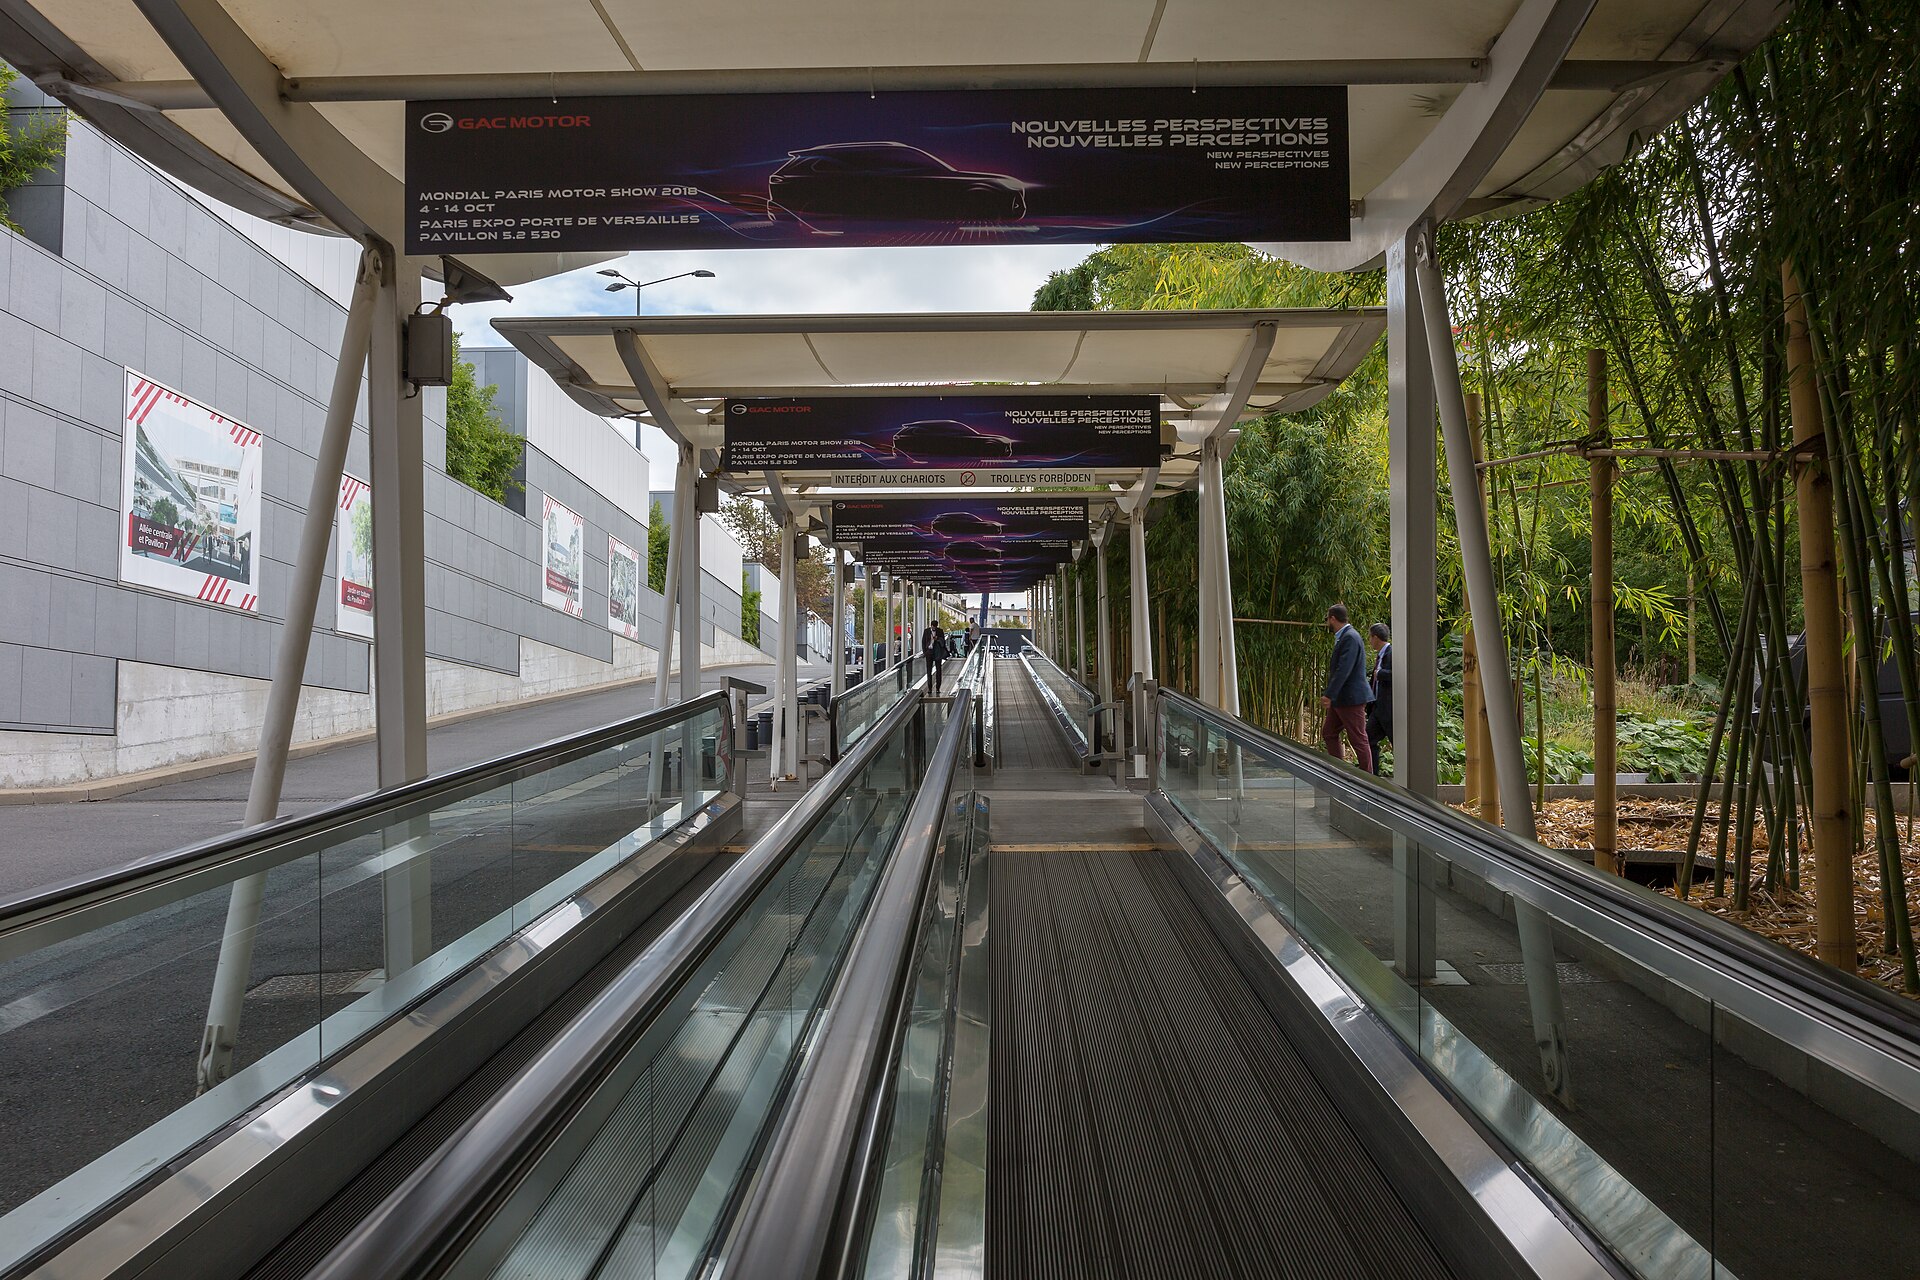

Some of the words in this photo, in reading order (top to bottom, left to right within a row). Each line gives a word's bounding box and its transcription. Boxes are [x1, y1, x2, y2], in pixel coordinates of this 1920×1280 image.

[458, 118, 506, 129] GAC
[510, 116, 591, 128] MOTOR
[1011, 119, 1148, 134] NOUVELLES
[1153, 117, 1329, 132] PERSPECTIVES
[1027, 134, 1162, 149] NOUVELLES
[1170, 132, 1329, 146] PERCEPTIONS
[1206, 151, 1234, 160] NEW
[1236, 150, 1330, 159] PERSPECTIVES
[1214, 161, 1242, 170] NEW
[1244, 160, 1329, 169] PERCEPTIONS
[420, 191, 490, 201] MONDIAL
[495, 190, 544, 200] PARIS
[547, 188, 607, 198] MOTOR
[610, 187, 657, 198] SHOW
[661, 187, 698, 196] 2018
[419, 205, 430, 213] 4
[444, 204, 460, 213] 14
[463, 203, 495, 213] OCT
[420, 219, 469, 229] PARIS
[473, 218, 517, 228] EXPO
[520, 216, 573, 227] PORTE
[578, 216, 598, 226] DE
[601, 214, 700, 225] VERSAILLES
[420, 231, 498, 242] PAVILLON
[502, 230, 526, 241] 5.2
[530, 230, 561, 240] 530
[1070, 409, 1152, 417] PERSPECTIVES
[1078, 416, 1152, 424] PERCEPTIONS
[835, 475, 877, 484] INTERDIT
[879, 475, 897, 484] AUX
[900, 474, 946, 484] CHARIOTS
[991, 474, 1036, 483] TROLLEYS
[1039, 473, 1091, 483] FORBIDDEN
[139, 523, 152, 534] Allée
[153, 529, 173, 540] centrale
[145, 536, 164, 549] Pavillon
[165, 542, 168, 550] 7
